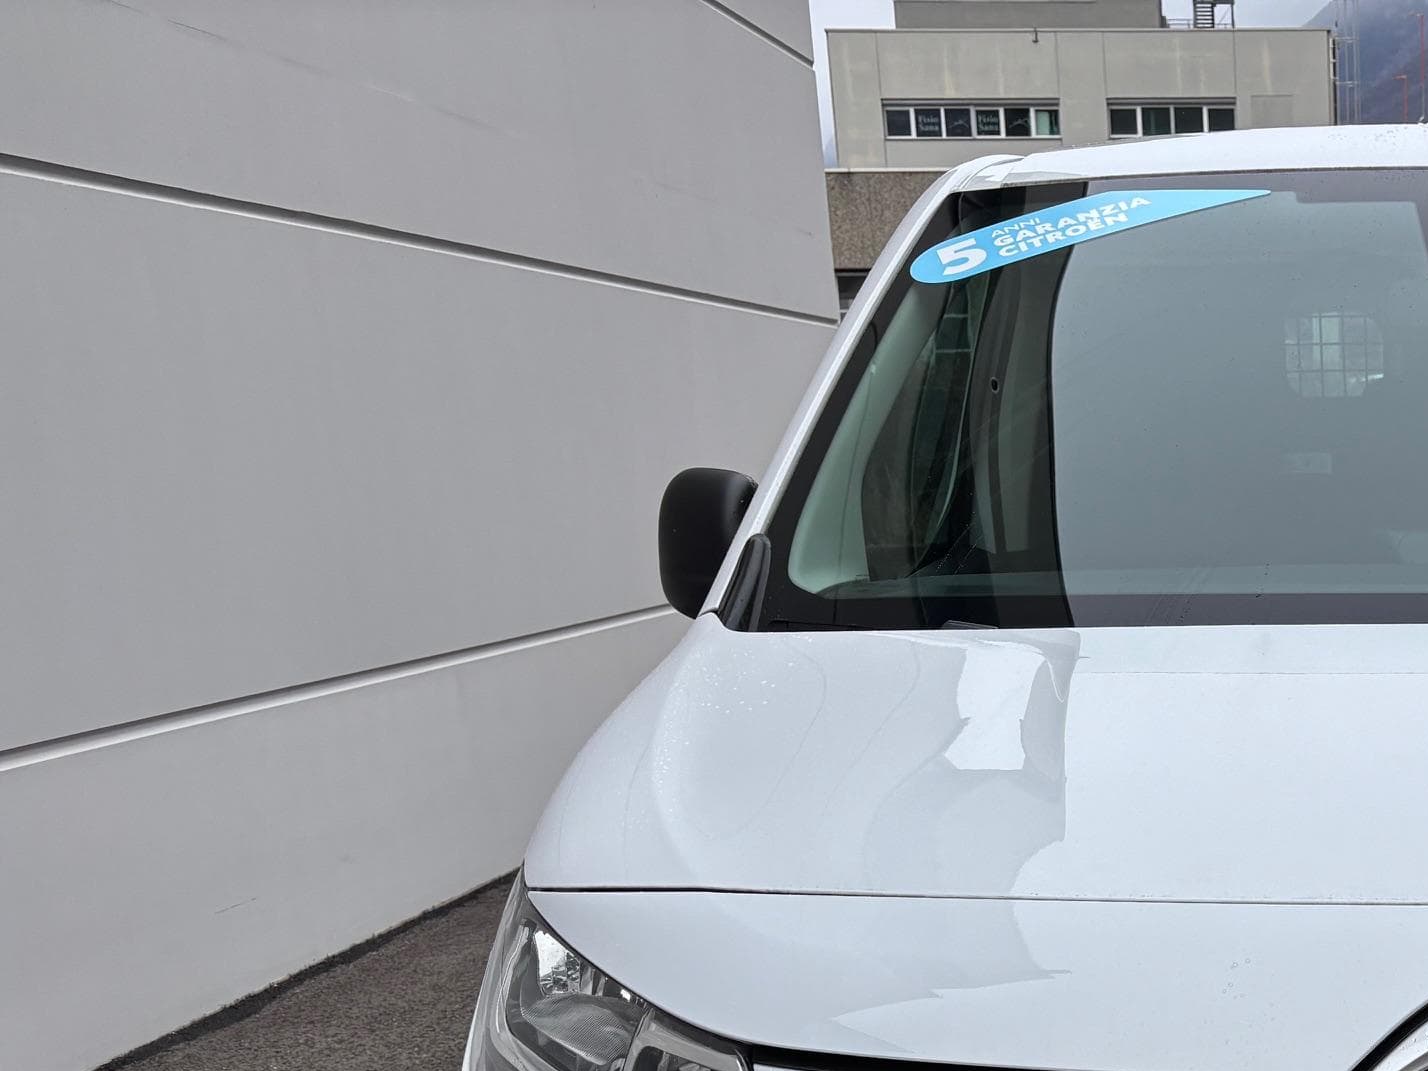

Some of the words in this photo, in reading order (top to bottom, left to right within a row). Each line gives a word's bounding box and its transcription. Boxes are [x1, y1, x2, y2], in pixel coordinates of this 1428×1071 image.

[991, 218, 1041, 238] ANNI
[993, 196, 1152, 247] GARANZIA
[936, 238, 988, 276] 5
